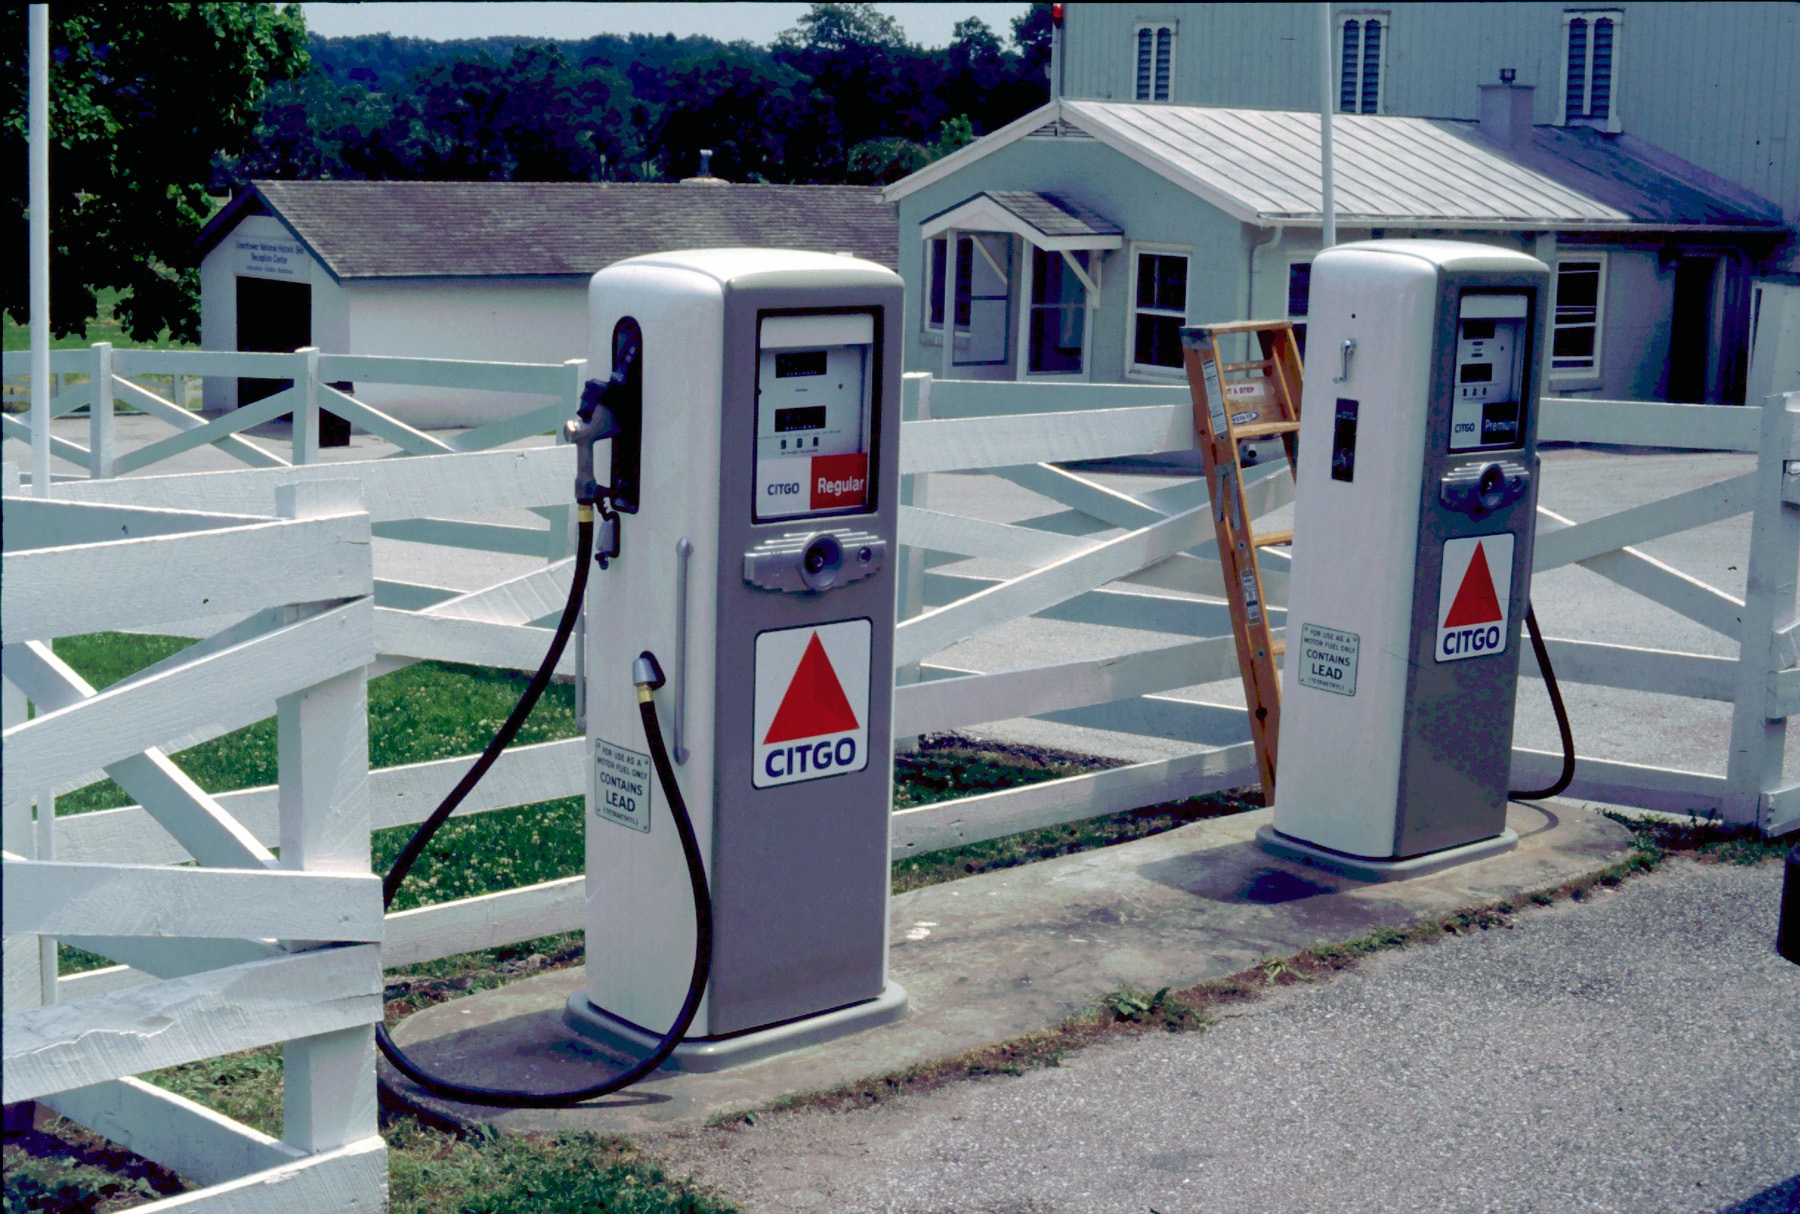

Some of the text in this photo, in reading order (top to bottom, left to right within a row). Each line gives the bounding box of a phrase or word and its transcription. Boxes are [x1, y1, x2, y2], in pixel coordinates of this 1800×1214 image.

[1454, 422, 1475, 433] CITGO
[767, 482, 800, 496] CITGO
[817, 476, 865, 497] Regular
[1310, 629, 1321, 637] FOR
[1322, 632, 1334, 640] USE
[1442, 625, 1500, 656] CITGO
[1304, 637, 1355, 654] MOTOR FUEL ONLY
[1306, 648, 1351, 667] CONTAINS
[1311, 662, 1343, 680] LEAD
[602, 746, 612, 757] FOR
[613, 752, 625, 762] USE
[626, 755, 635, 765] AS
[765, 736, 856, 778] CITGO
[597, 757, 647, 780] MOTOR FUEL ONLY
[600, 771, 643, 796] CONTAINS
[606, 789, 636, 812] LEAD
